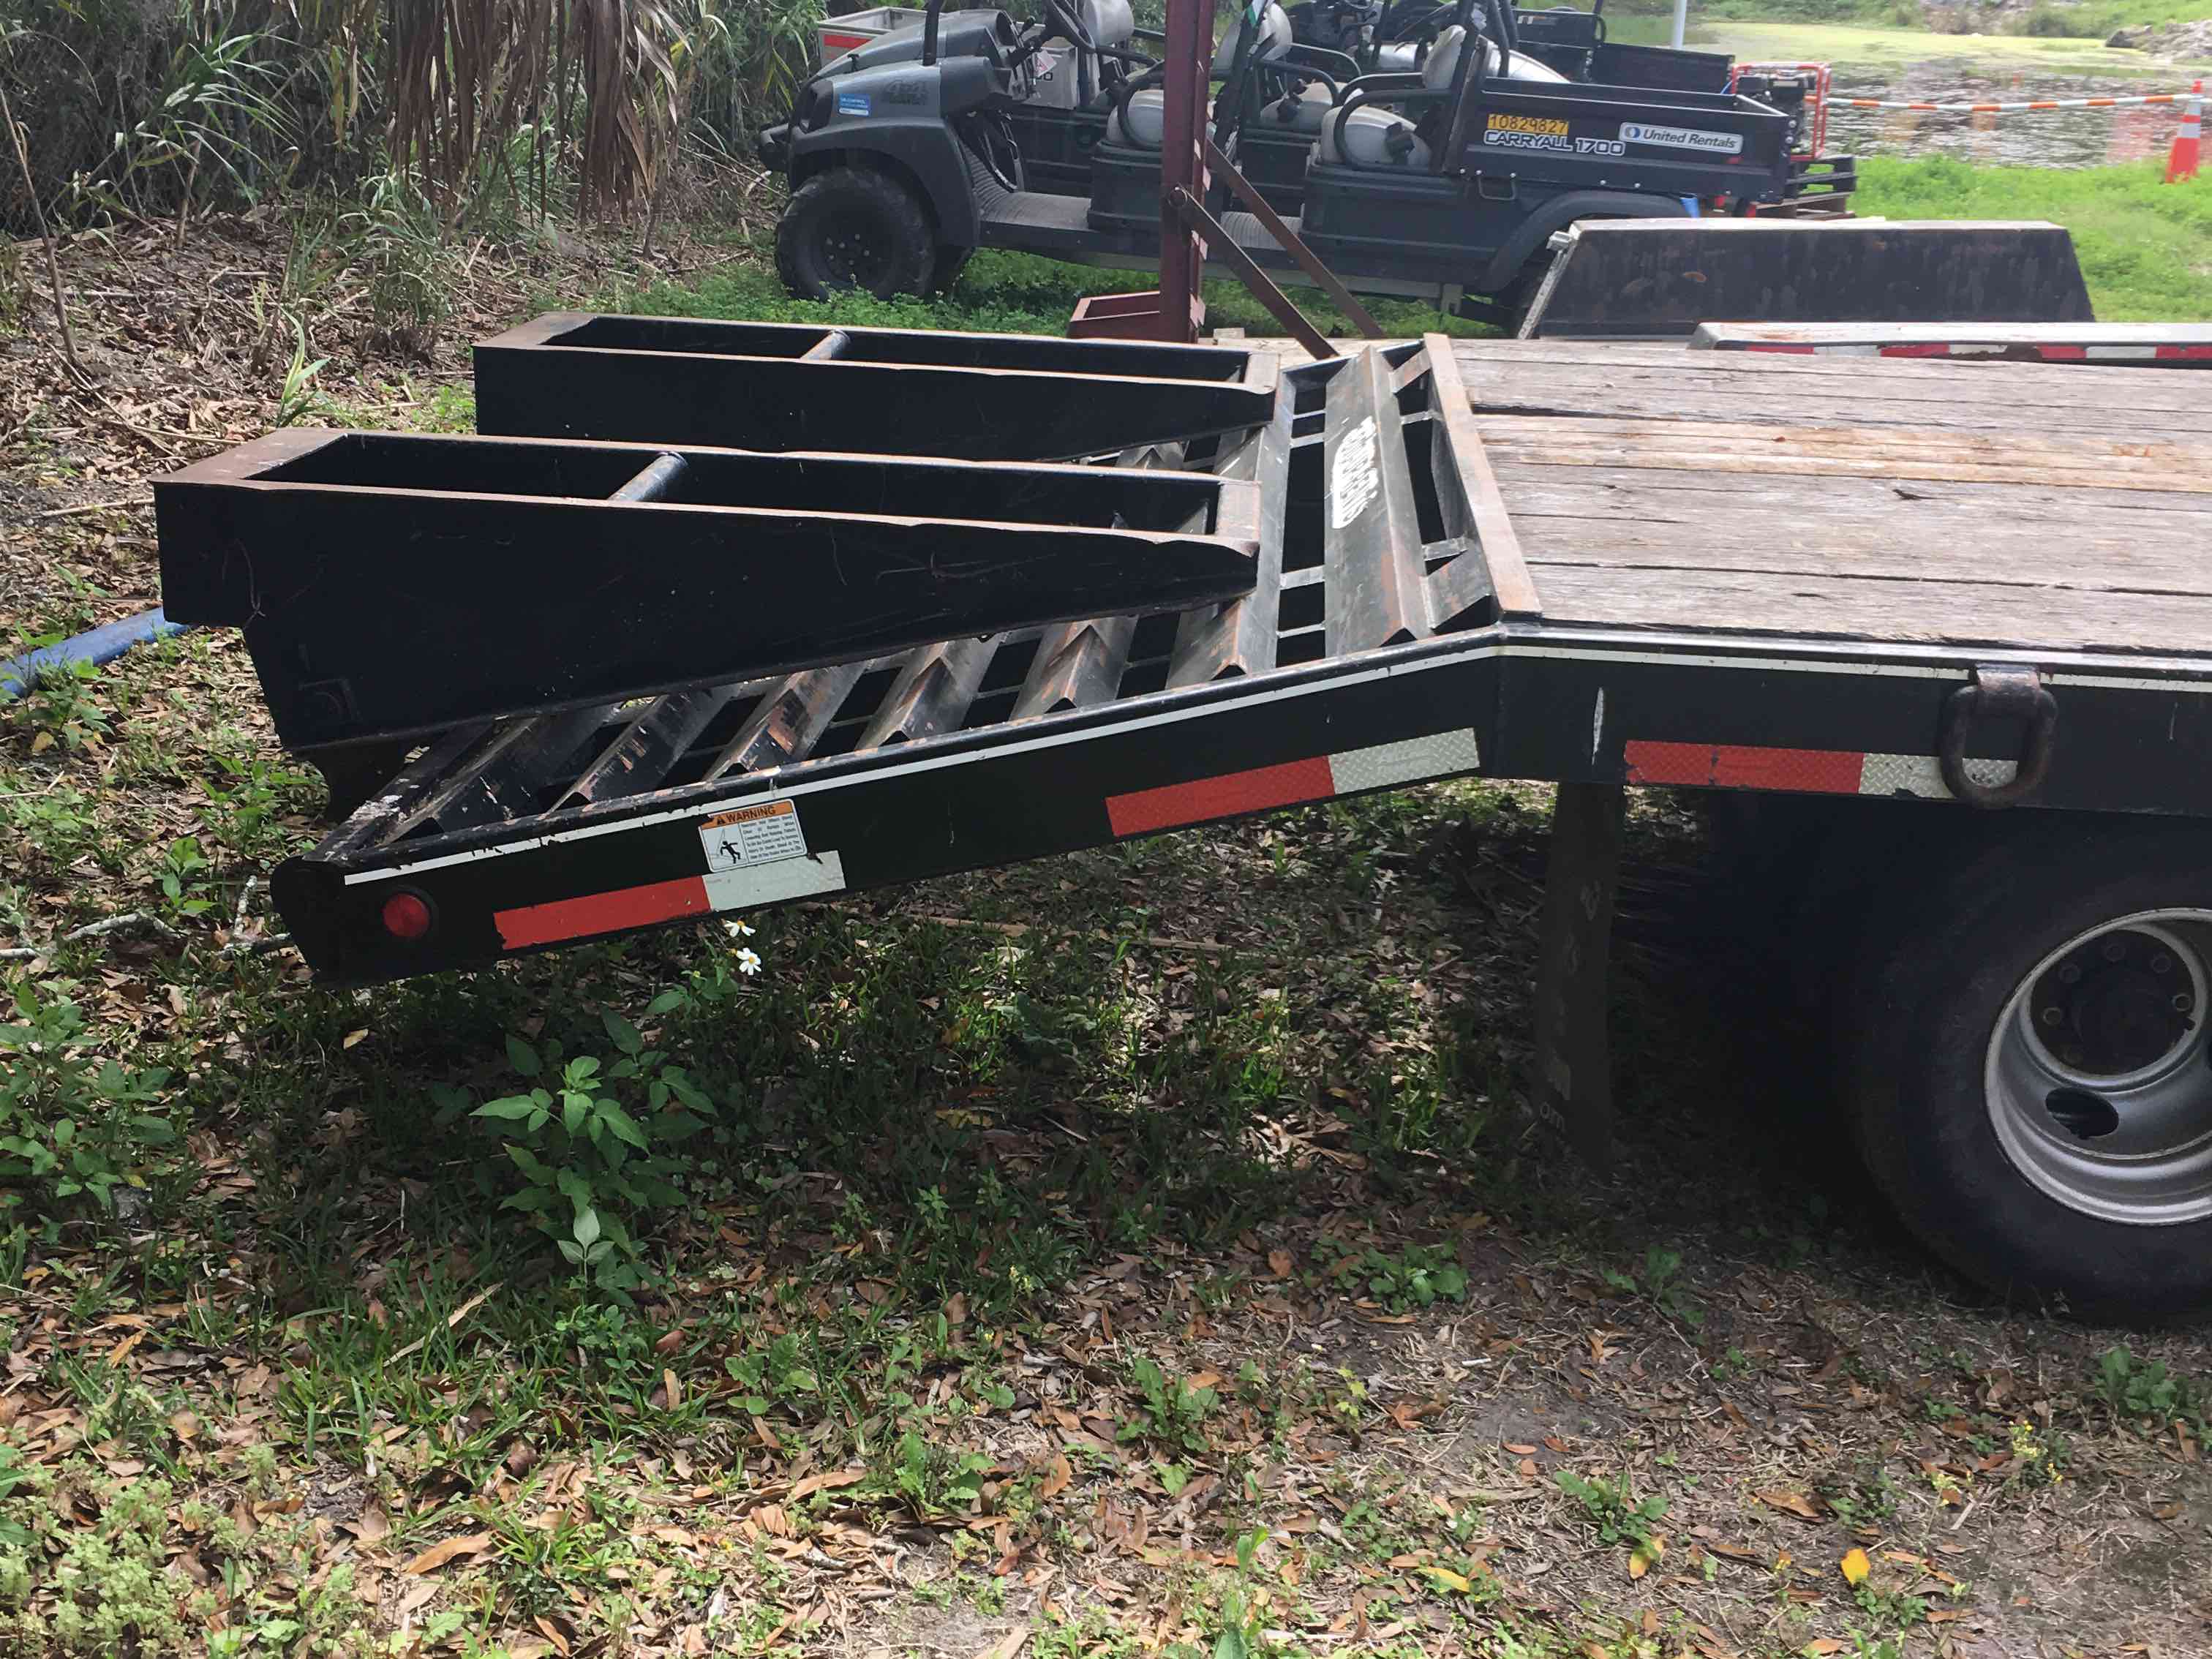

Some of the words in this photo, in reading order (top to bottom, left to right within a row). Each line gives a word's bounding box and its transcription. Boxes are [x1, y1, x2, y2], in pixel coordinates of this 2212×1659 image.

[1489, 115, 1567, 135] 10829827
[1483, 129, 1573, 151] CARRYALL
[1575, 138, 1625, 156] 1700
[1644, 128, 1686, 143] United
[1688, 134, 1737, 148] Rentals
[726, 806, 776, 824] WARNING
